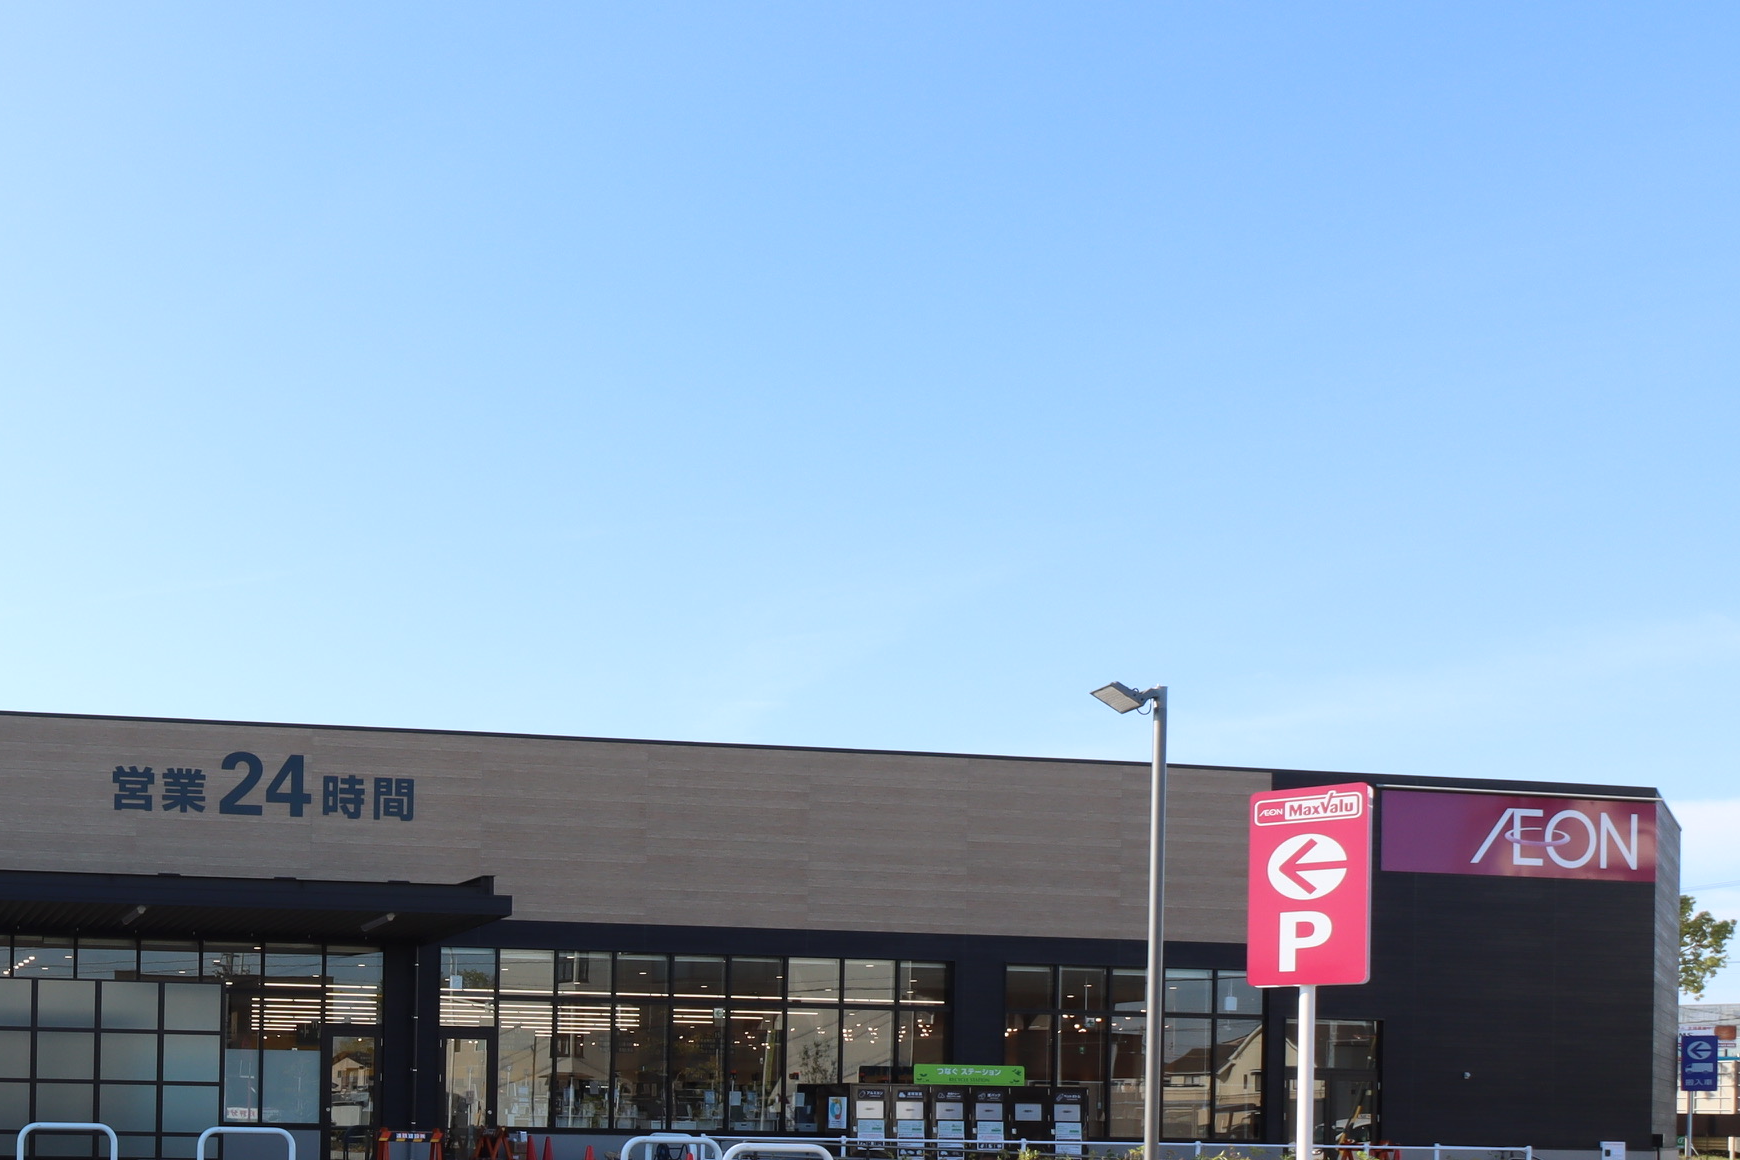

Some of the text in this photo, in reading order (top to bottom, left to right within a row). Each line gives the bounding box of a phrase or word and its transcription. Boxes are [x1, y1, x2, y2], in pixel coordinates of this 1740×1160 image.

[111, 750, 416, 822] 営業24時間
[1288, 792, 1354, 817] MaxValu
[1278, 910, 1333, 973] P
